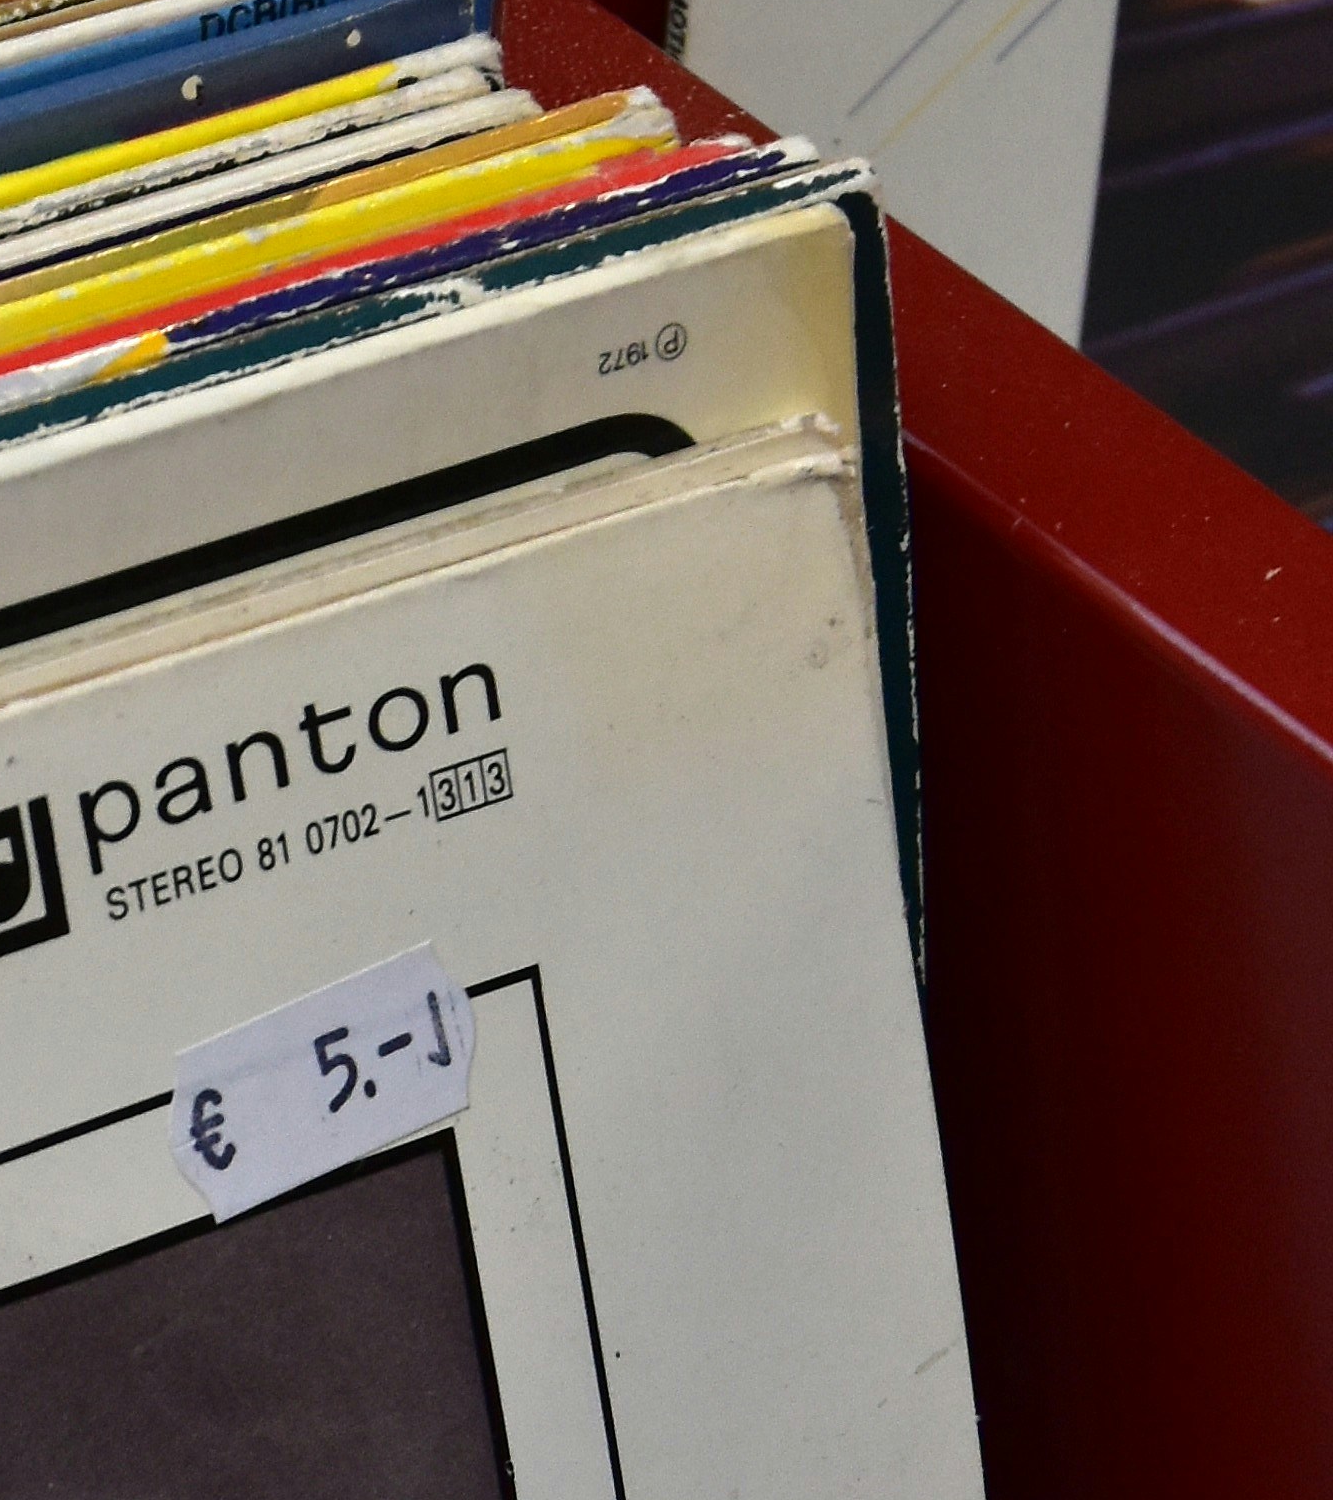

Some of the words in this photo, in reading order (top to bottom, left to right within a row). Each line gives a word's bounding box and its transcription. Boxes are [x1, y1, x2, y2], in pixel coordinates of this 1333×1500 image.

[598, 341, 651, 375] 1972
[78, 660, 504, 875] panton
[105, 847, 245, 922] STEREO
[256, 831, 292, 873] 81
[189, 1087, 237, 1172] €
